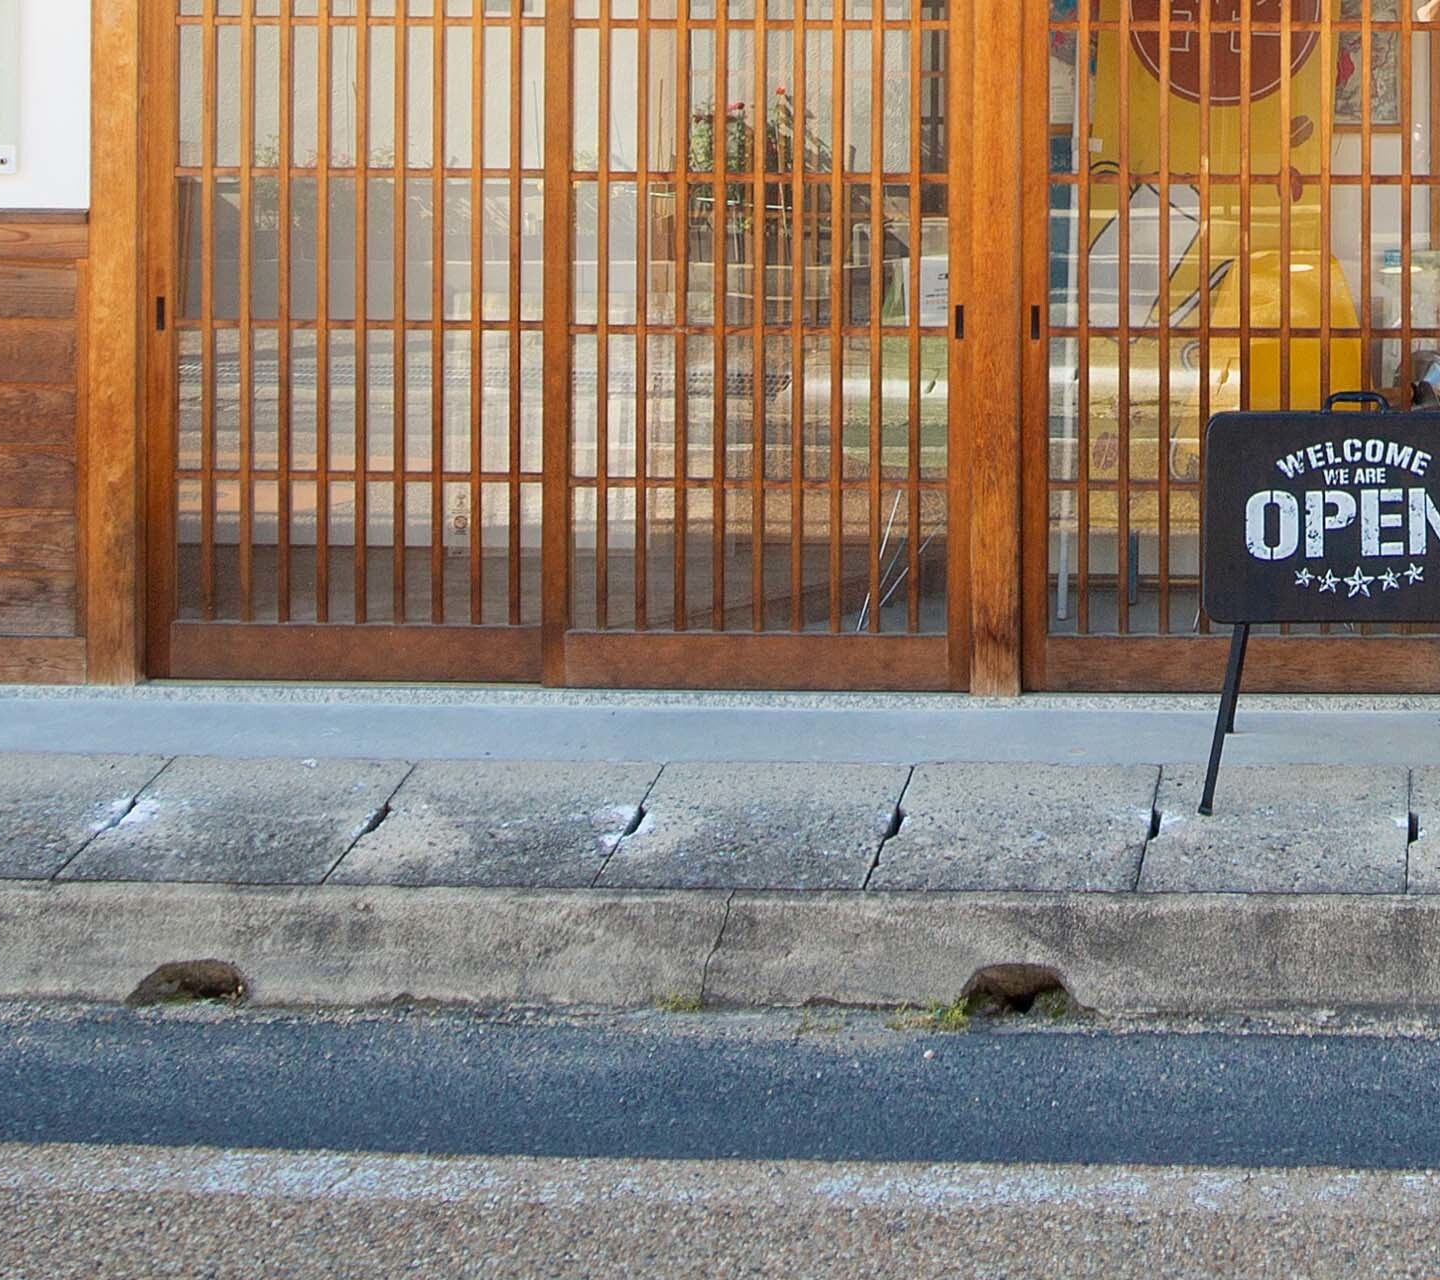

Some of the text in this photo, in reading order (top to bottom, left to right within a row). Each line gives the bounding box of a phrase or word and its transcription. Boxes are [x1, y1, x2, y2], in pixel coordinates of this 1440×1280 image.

[1276, 438, 1432, 480] WELCOME
[1323, 468, 1386, 485] WE ARE
